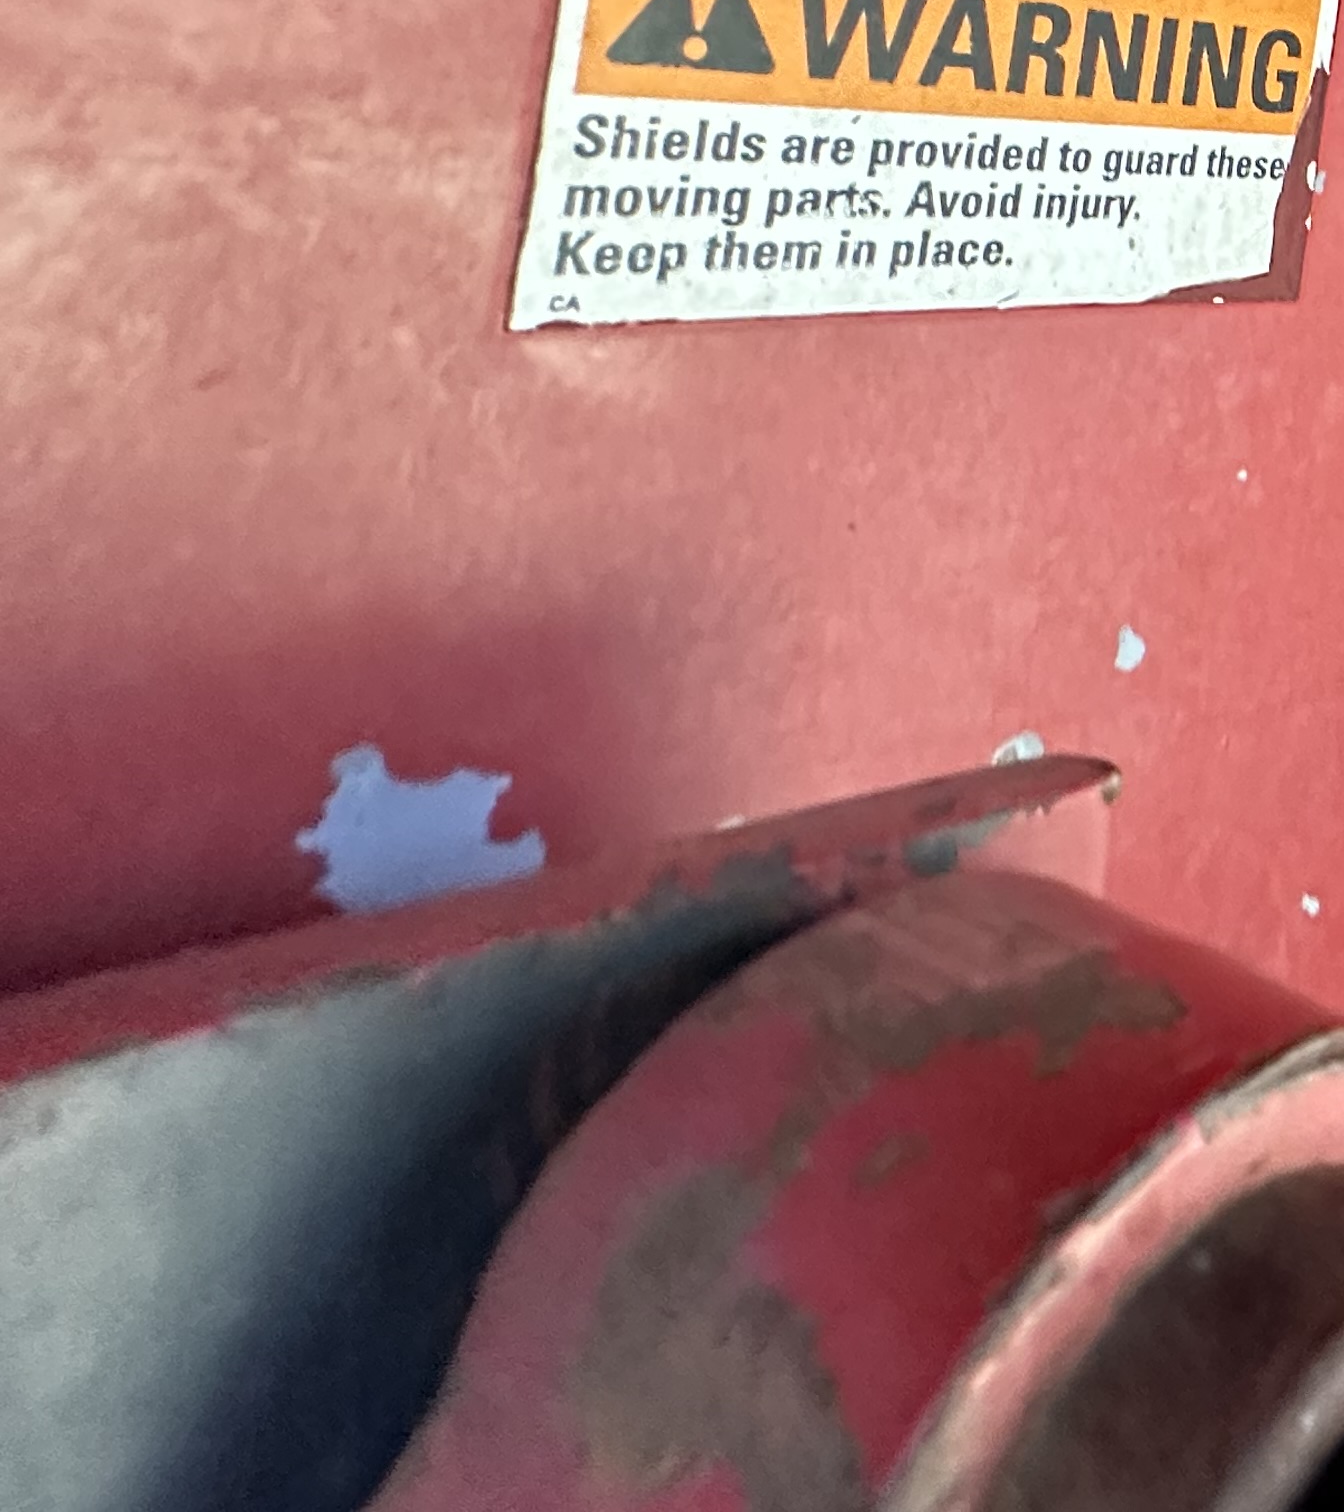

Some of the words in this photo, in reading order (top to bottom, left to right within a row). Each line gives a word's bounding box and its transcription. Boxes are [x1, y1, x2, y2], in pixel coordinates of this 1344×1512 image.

[573, 114, 768, 163] Shields
[781, 133, 854, 166] are
[867, 131, 1049, 178] provided
[1057, 140, 1093, 174] to
[1101, 144, 1200, 182] guard
[1204, 144, 1287, 181] these
[562, 173, 752, 227] moving
[763, 181, 892, 229] parts.
[904, 180, 1023, 220] Avoid
[1031, 183, 1142, 229] injury.
[552, 229, 688, 285] Keep
[703, 229, 823, 272] them
[835, 228, 877, 270] in
[887, 229, 1014, 280] place.
[547, 293, 581, 313] CA
